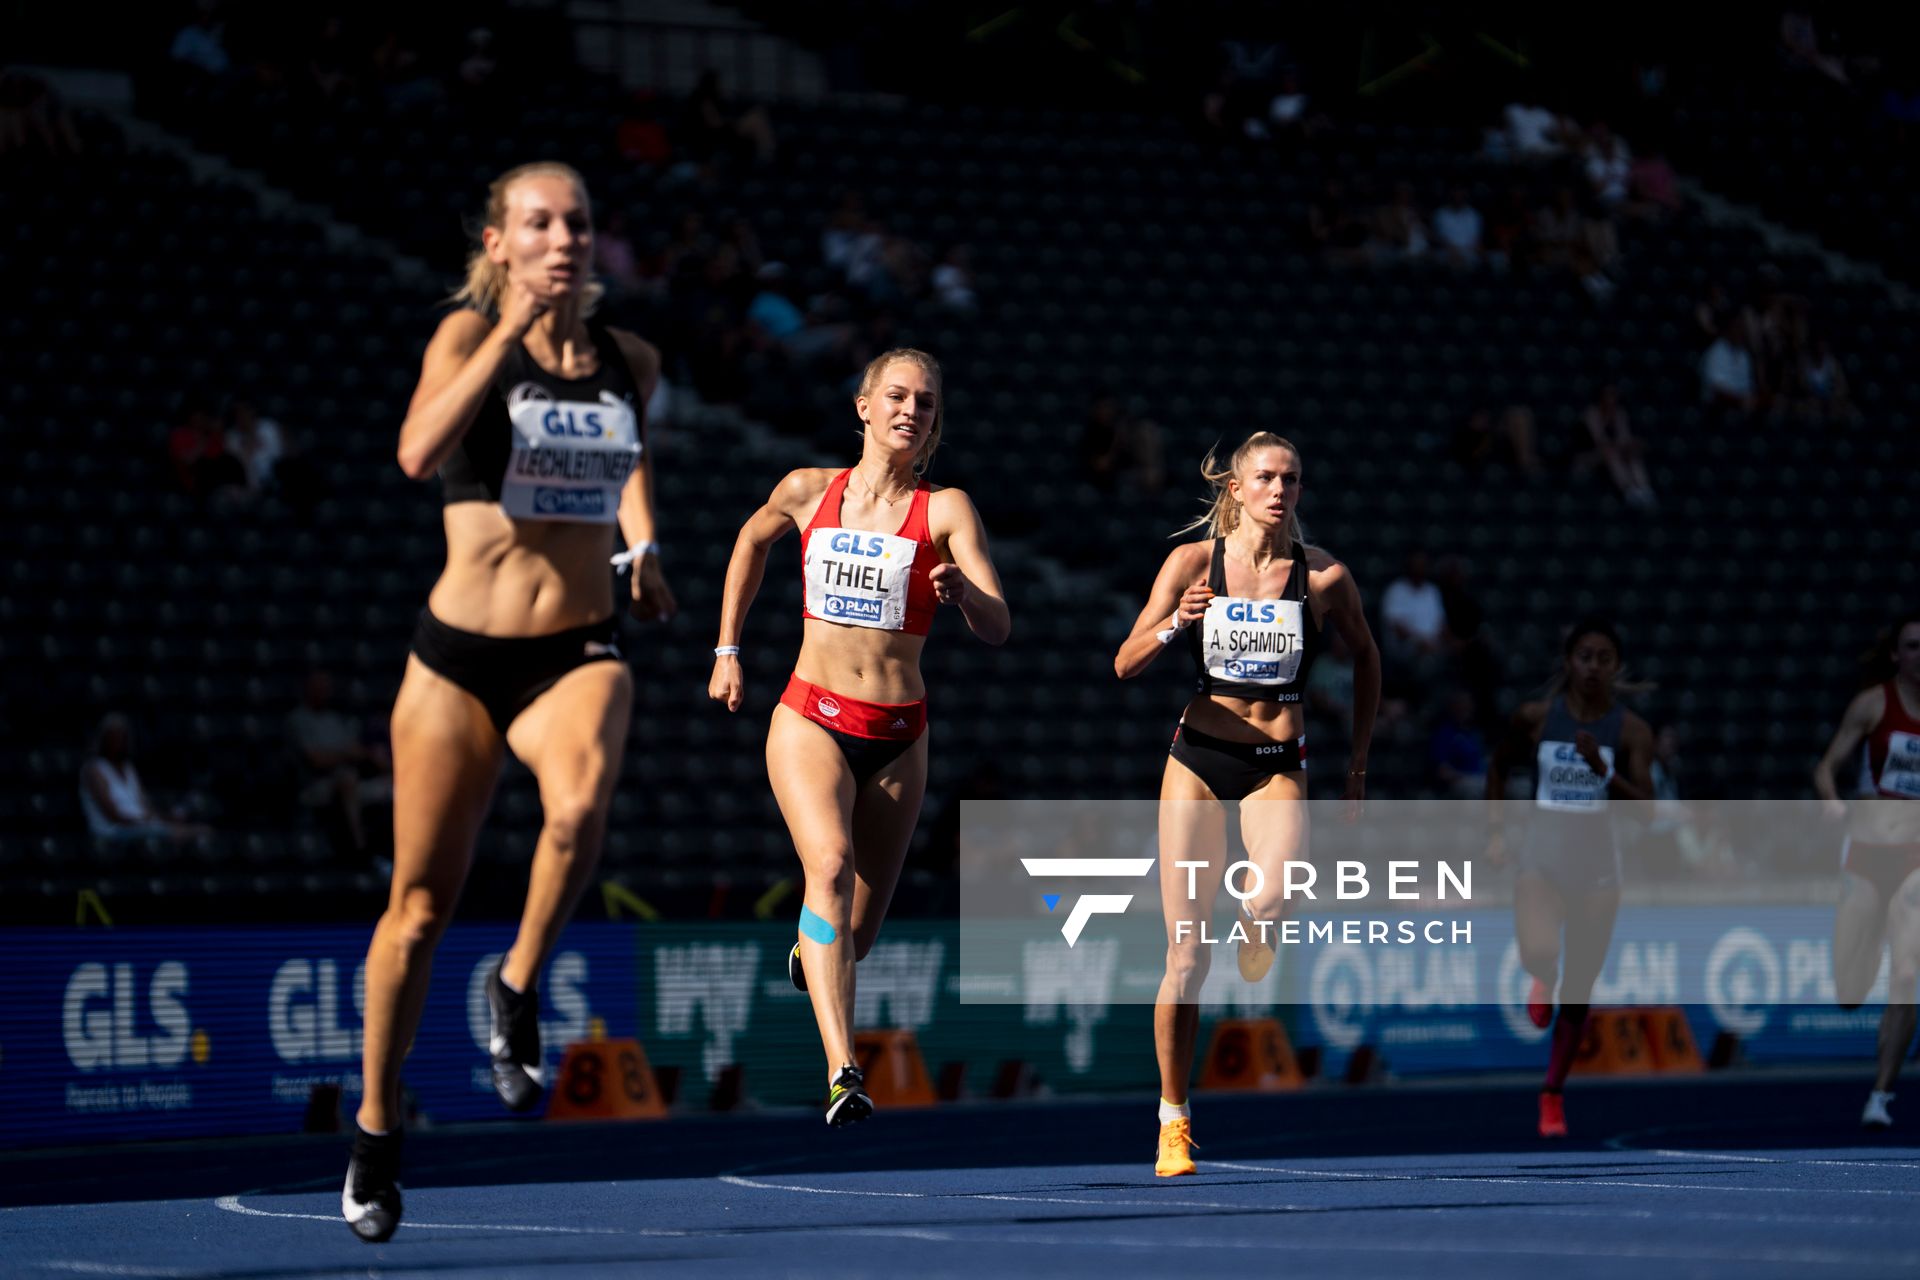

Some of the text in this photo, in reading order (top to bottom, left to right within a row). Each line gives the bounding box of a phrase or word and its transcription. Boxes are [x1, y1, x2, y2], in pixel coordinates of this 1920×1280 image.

[515, 449, 637, 482] LECHLEITNER
[822, 559, 889, 593] THIEL
[845, 599, 880, 614] PLAN
[1210, 629, 1296, 655] A. SCHMIDT
[1246, 663, 1278, 673] PLAN
[1278, 693, 1299, 702] BOSS
[1256, 745, 1284, 755] BOSS
[564, 1051, 603, 1104] 8
